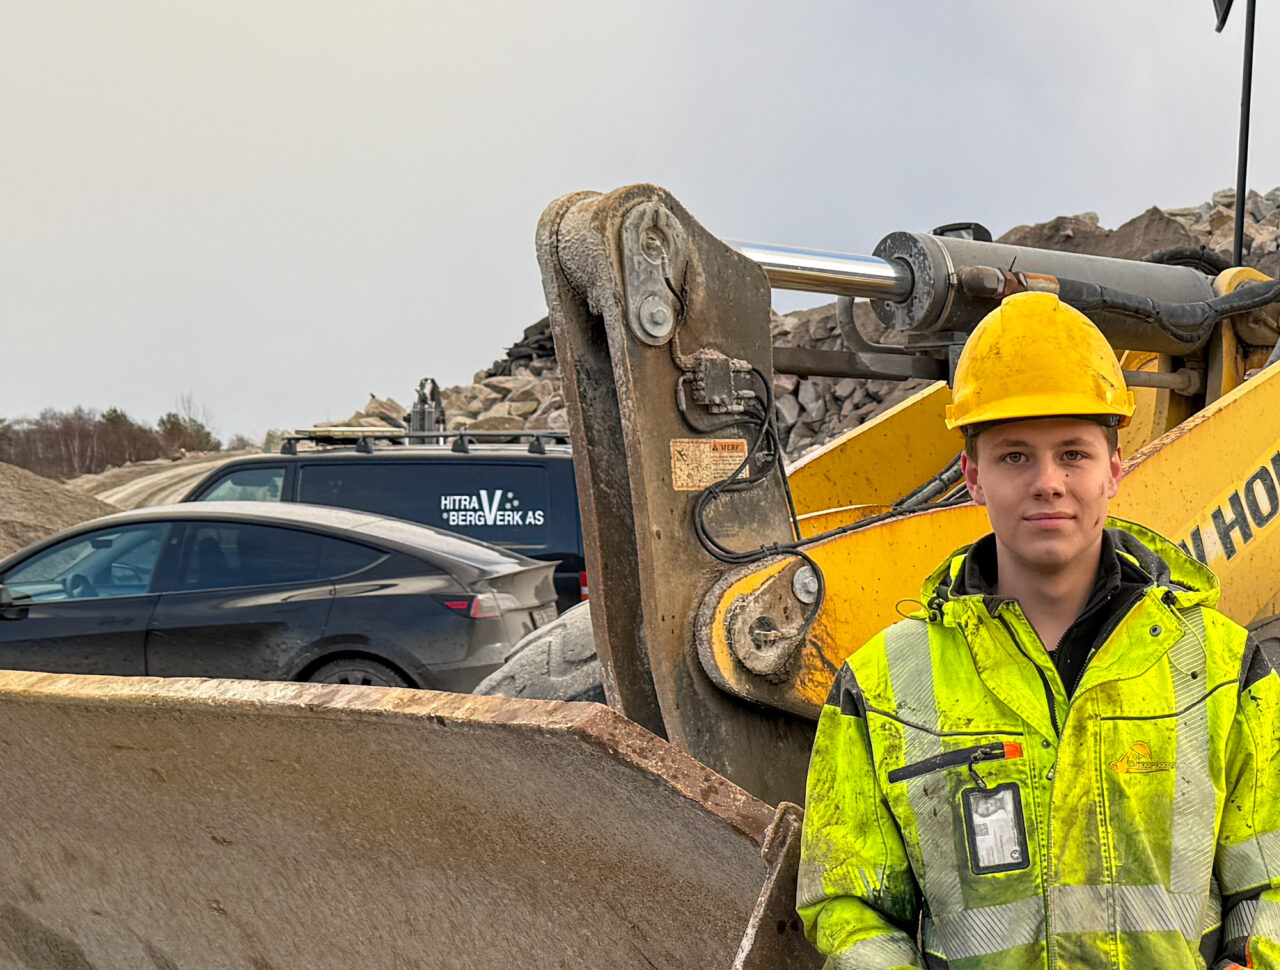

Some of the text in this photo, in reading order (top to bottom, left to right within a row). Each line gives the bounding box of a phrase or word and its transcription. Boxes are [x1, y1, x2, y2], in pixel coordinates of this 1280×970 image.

[440, 495, 479, 510] HITRA
[449, 489, 544, 525] BERGVERK AS
